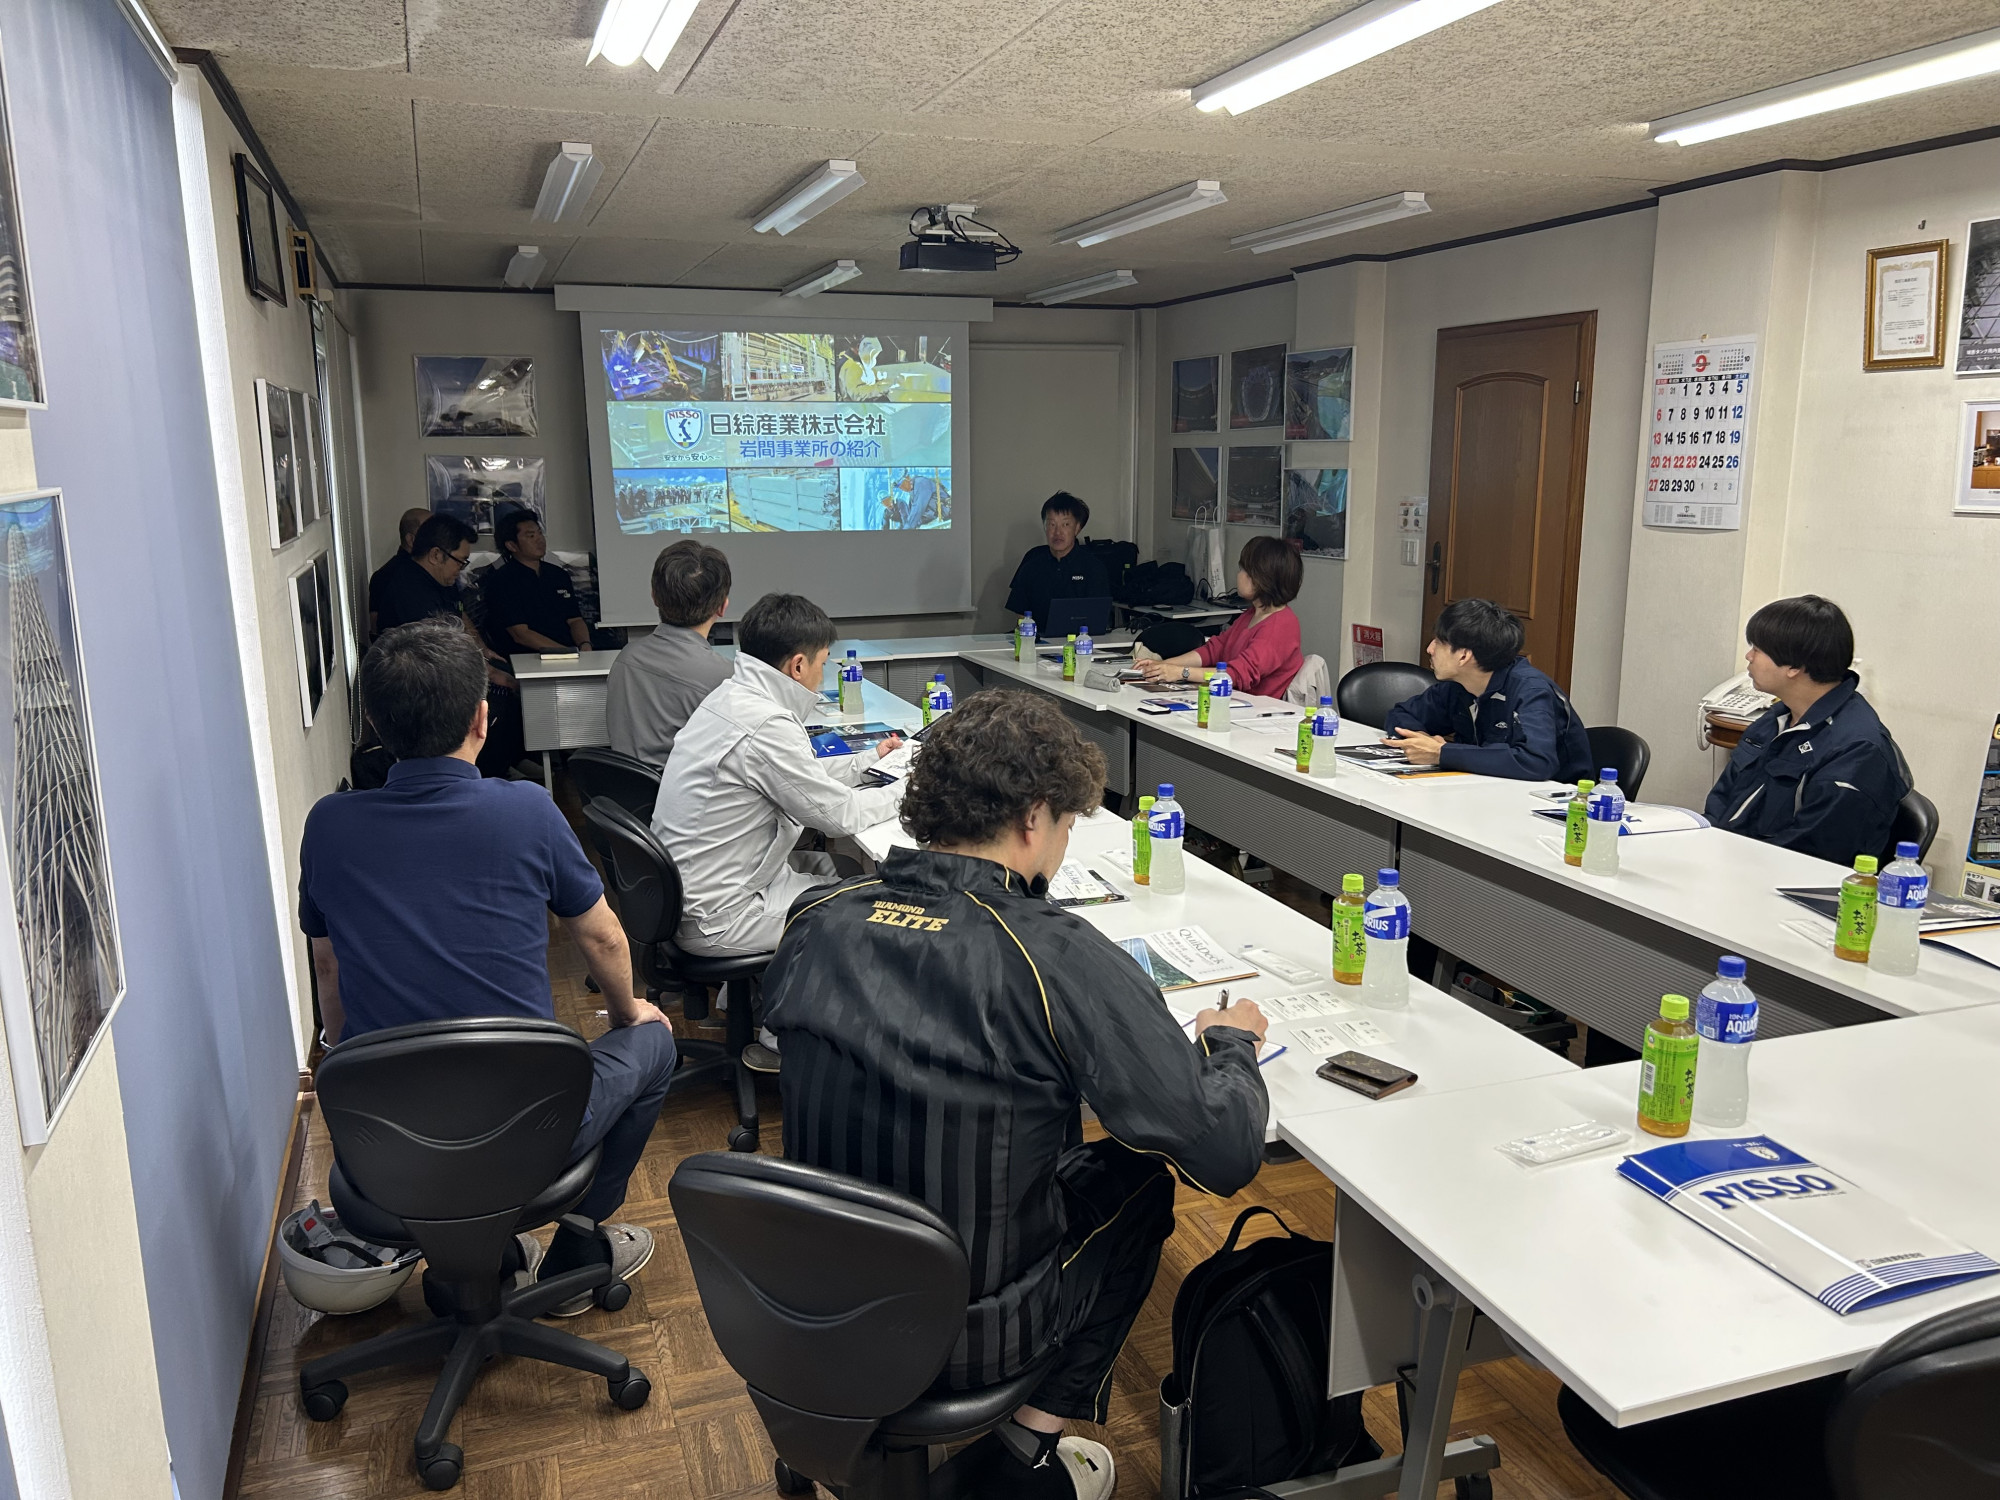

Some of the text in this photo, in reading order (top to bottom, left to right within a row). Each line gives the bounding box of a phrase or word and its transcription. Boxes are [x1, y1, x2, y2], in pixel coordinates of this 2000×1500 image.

[1696, 355, 1707, 373] 9
[1683, 384, 1688, 396] 1
[1696, 383, 1702, 395] 2
[1709, 382, 1715, 395] 3
[1722, 381, 1728, 394] 4
[1736, 380, 1743, 393] 5
[669, 410, 700, 420] NISSO
[1657, 406, 1743, 421] 6 7 8 9 10 11 12
[710, 413, 886, 436] 日綜産業株式会社
[1653, 430, 1740, 445] 13 14 15 16 17 18 19
[740, 440, 881, 458] 岩間事業所の紹介
[1650, 456, 1739, 468] 20 21 22 23 24 25 26
[1648, 479, 1659, 491] 27
[1659, 480, 1670, 491] 28
[1671, 480, 1682, 492] 29
[1684, 480, 1695, 492] 30
[872, 900, 925, 915] DIAMOND
[866, 909, 949, 931] ELITE
[1853, 909, 1868, 935] お茶
[1699, 1174, 1836, 1210] NISSO
